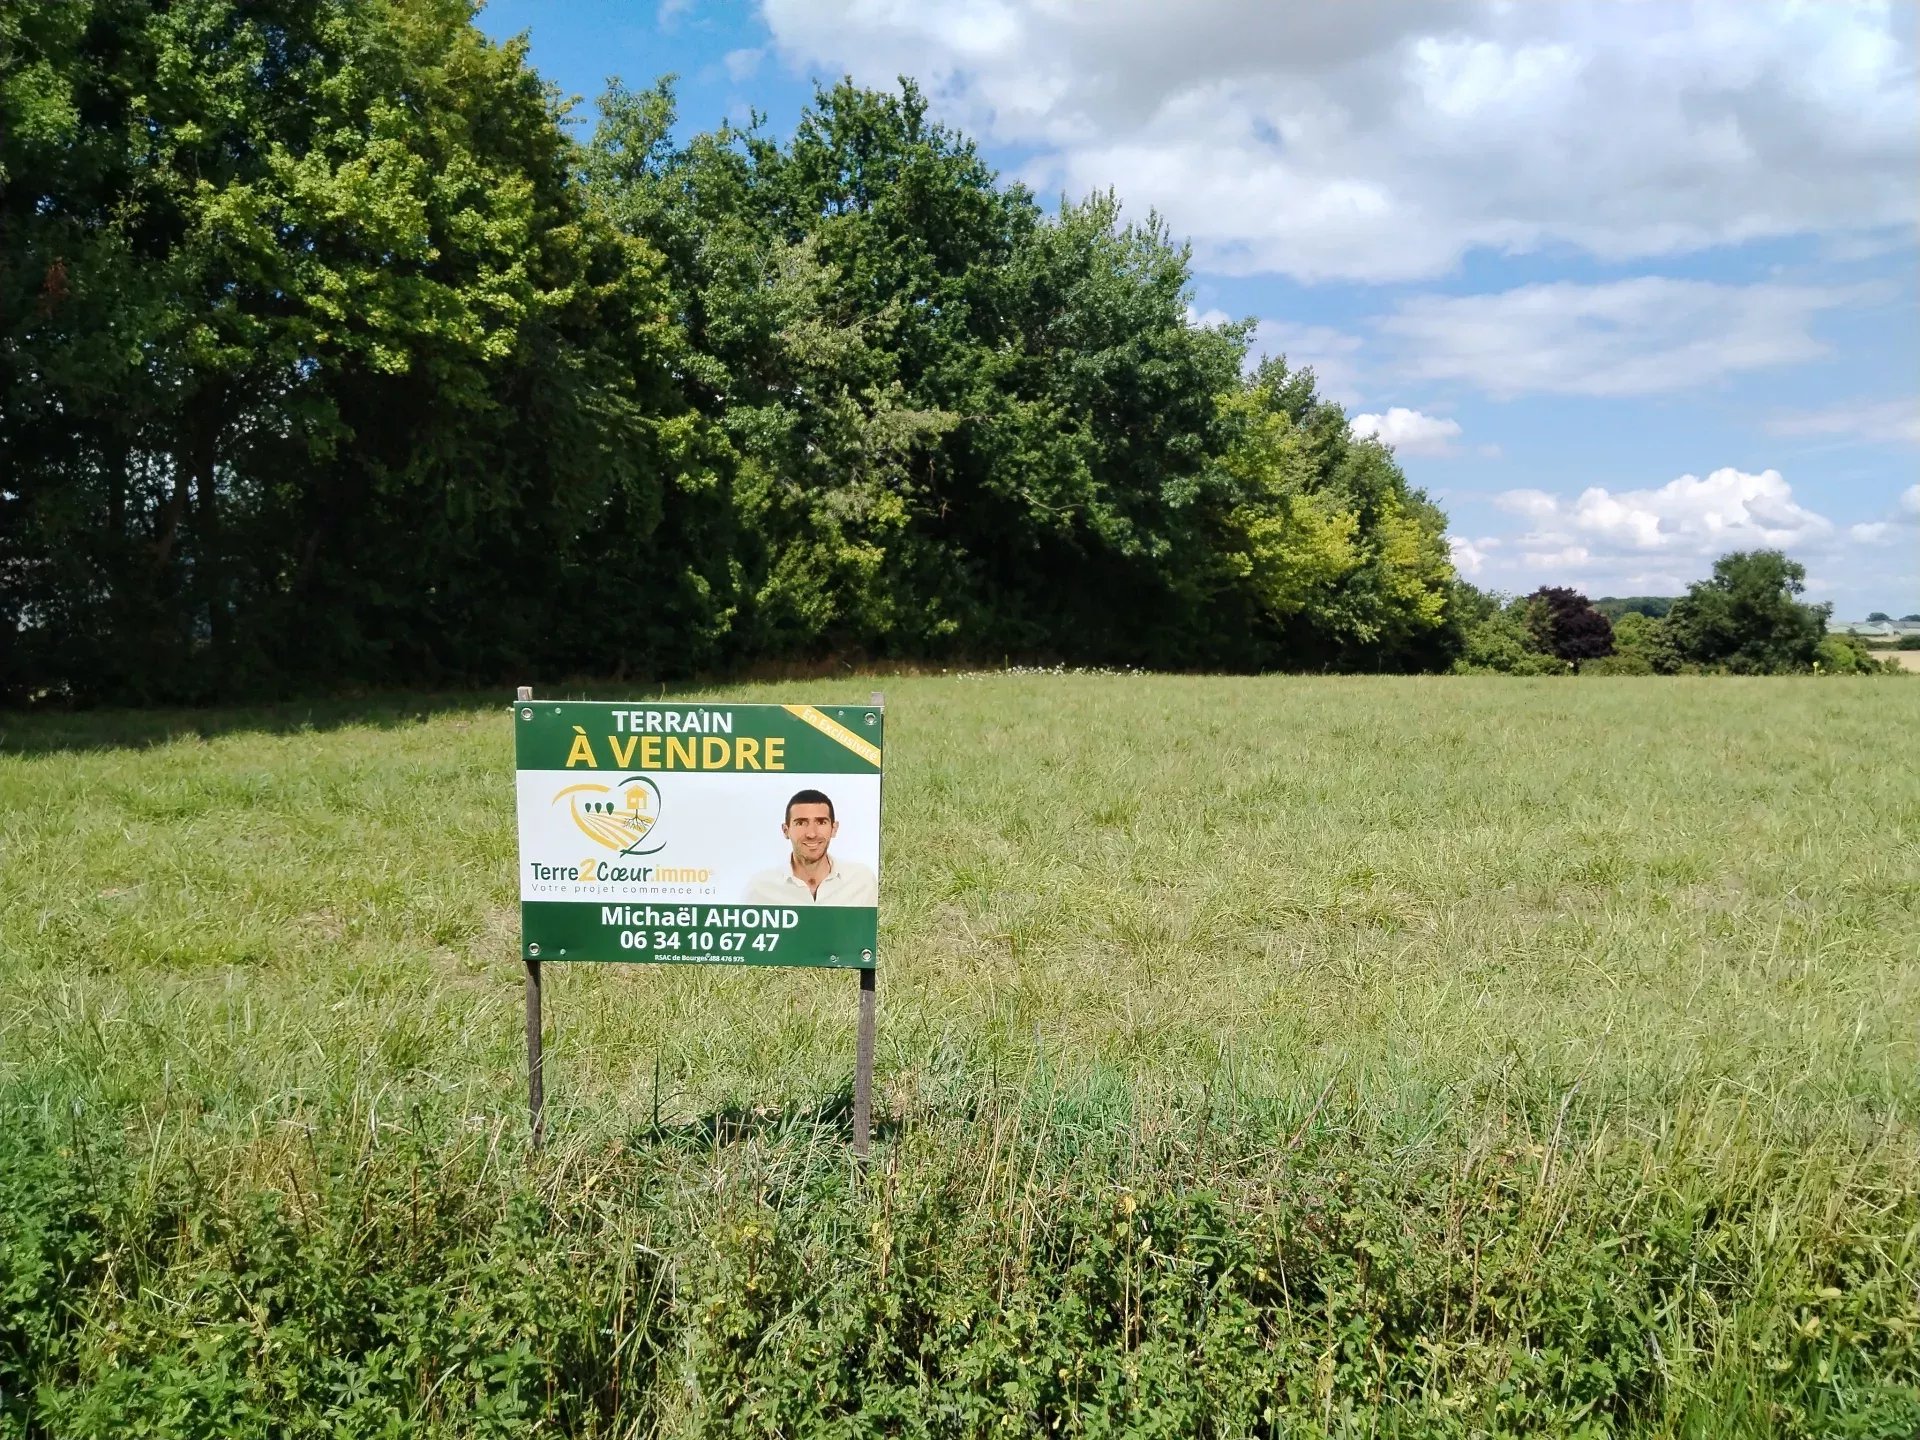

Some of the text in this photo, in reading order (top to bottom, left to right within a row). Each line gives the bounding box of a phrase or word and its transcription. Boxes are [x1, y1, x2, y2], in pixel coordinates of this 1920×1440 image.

[612, 710, 732, 733] TERRAIN
[566, 726, 785, 770] À VENDRE
[531, 883, 567, 892] Votre
[574, 885, 615, 895] projet
[622, 886, 692, 895] commence
[601, 906, 799, 929] Michaël AHOND
[620, 931, 780, 952] 06 34 10 67 47
[681, 954, 708, 962] Bourges
